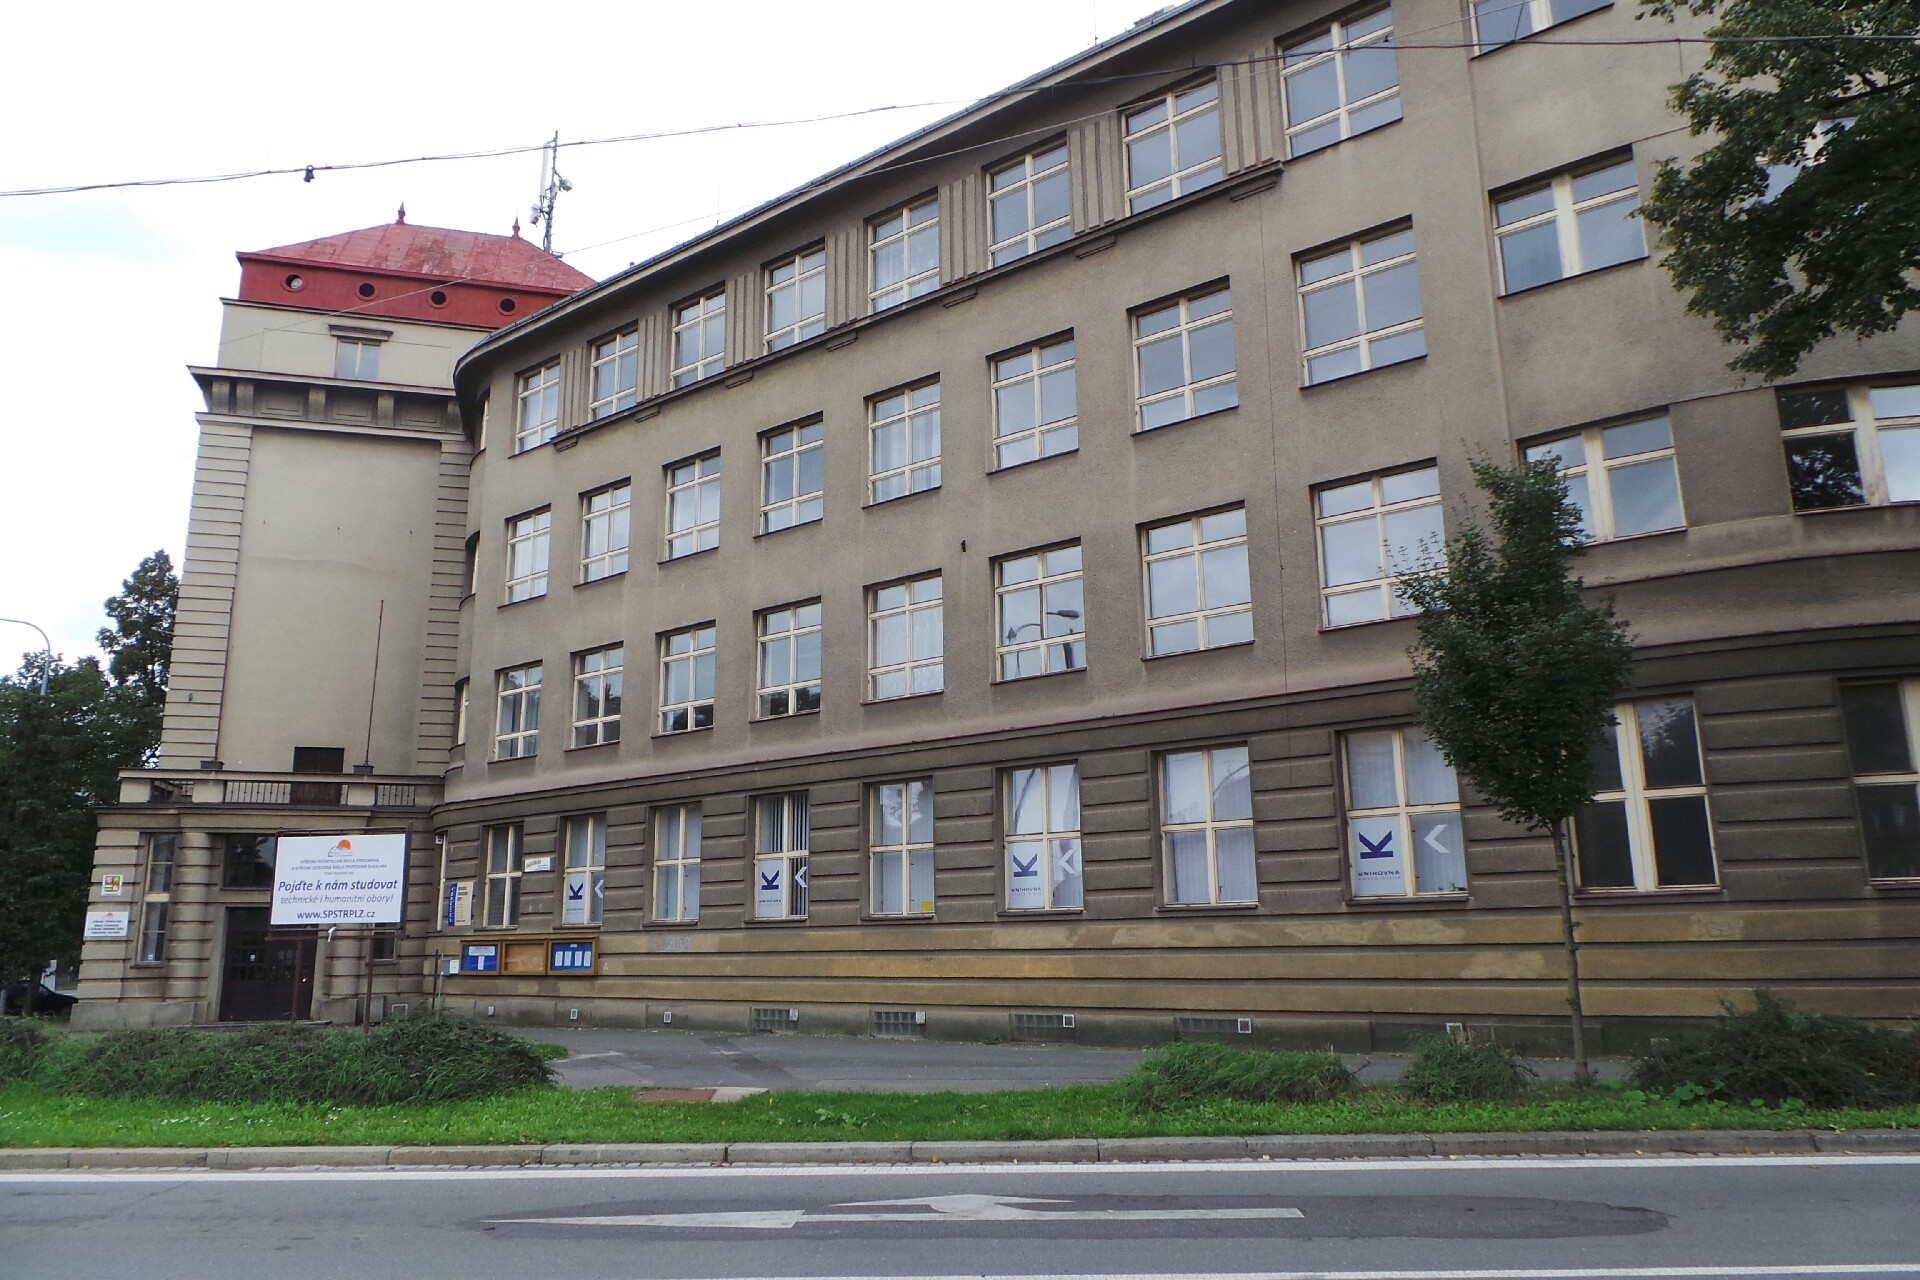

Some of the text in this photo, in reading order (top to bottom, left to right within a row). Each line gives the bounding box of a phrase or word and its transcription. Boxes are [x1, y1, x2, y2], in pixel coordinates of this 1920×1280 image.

[278, 879, 398, 893] Pojďte k nám studovat
[280, 894, 394, 904] technické i humanitní obory!
[297, 910, 375, 919] www.SPSTRPLZ.cz
